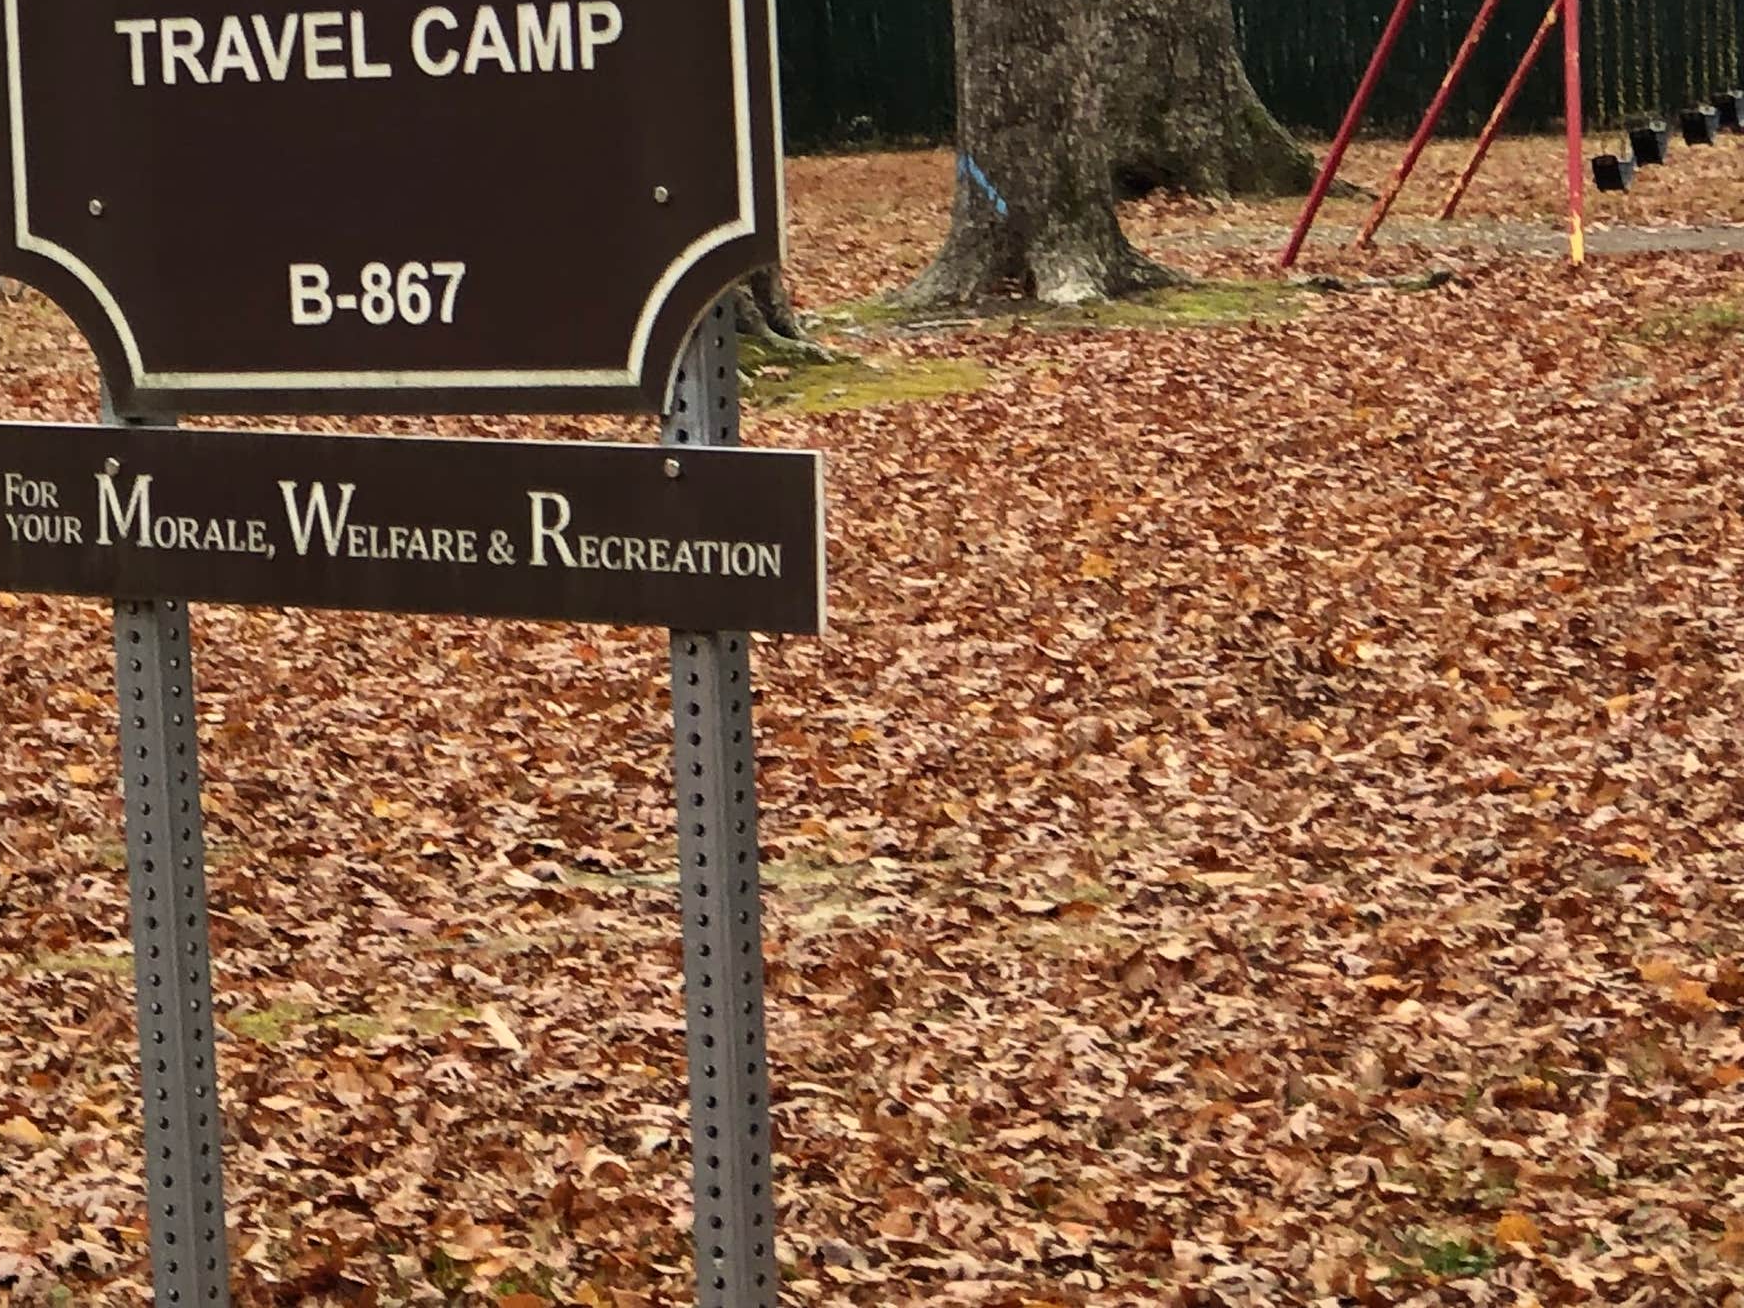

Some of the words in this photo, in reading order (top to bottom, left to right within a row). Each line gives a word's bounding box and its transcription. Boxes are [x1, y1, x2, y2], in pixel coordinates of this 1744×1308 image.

[114, 10, 393, 87] TRAVEL
[411, 0, 624, 78] CAMP
[289, 261, 467, 326] B-867
[5, 513, 84, 545] YOUR
[487, 529, 517, 566] &
